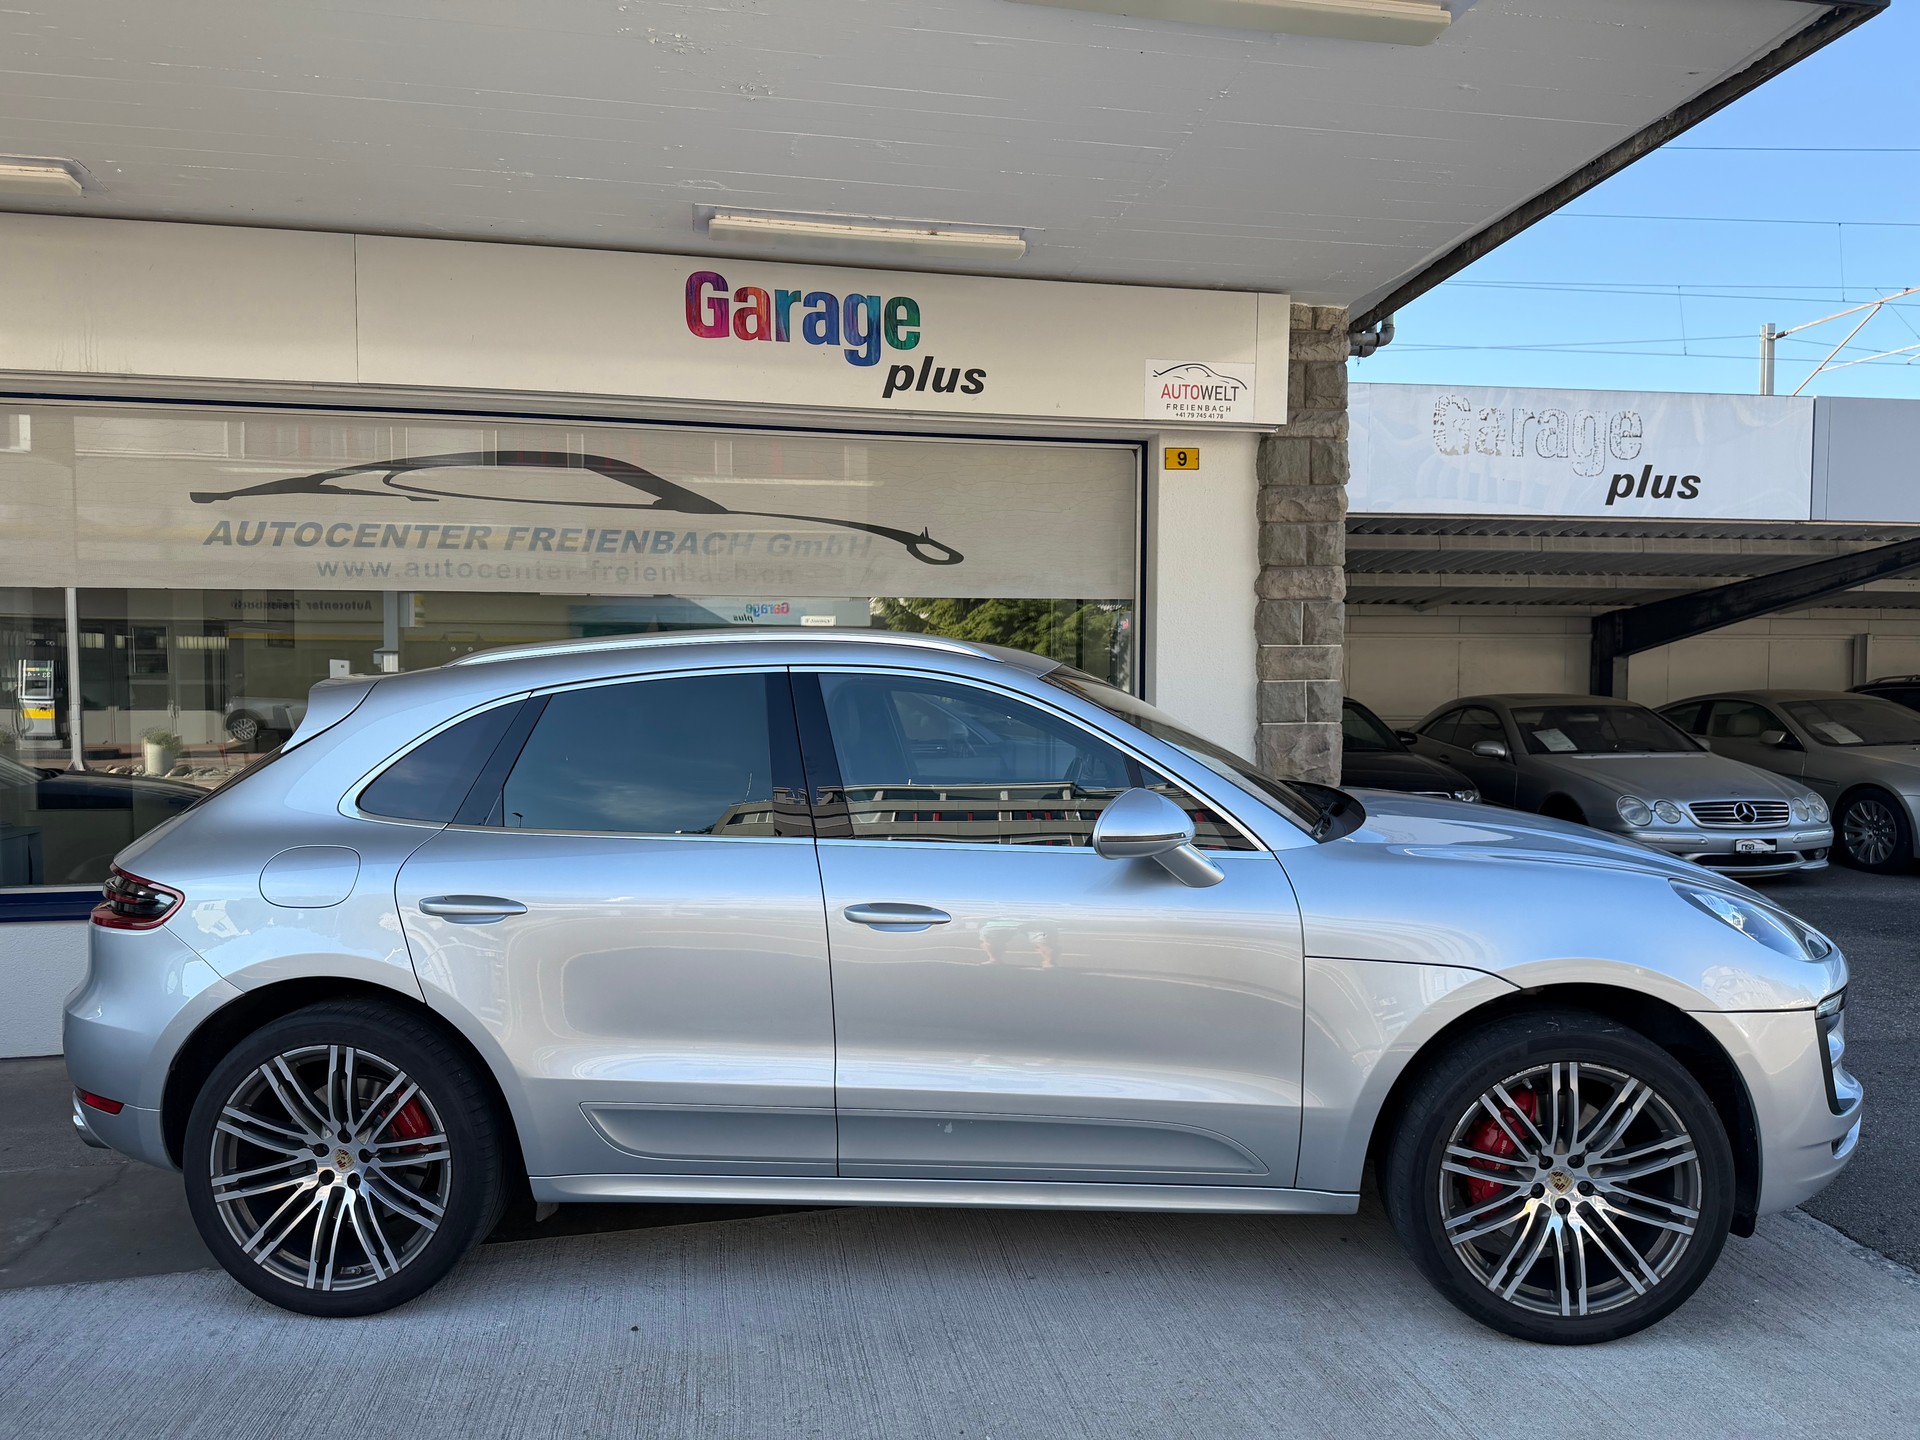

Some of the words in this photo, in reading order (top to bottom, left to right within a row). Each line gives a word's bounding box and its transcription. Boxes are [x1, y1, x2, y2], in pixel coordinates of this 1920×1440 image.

[685, 270, 921, 367] Garage
[881, 355, 987, 399] plus
[1160, 383, 1240, 402] AUTOWELT
[1165, 403, 1232, 413] FREIENBACH
[1432, 394, 1643, 477] Garage
[1177, 451, 1188, 467] 9
[1605, 464, 1702, 506] plus
[202, 520, 493, 551] AUTOCENTER
[503, 526, 756, 557] FREIENBACH
[766, 532, 873, 558] GmbH
